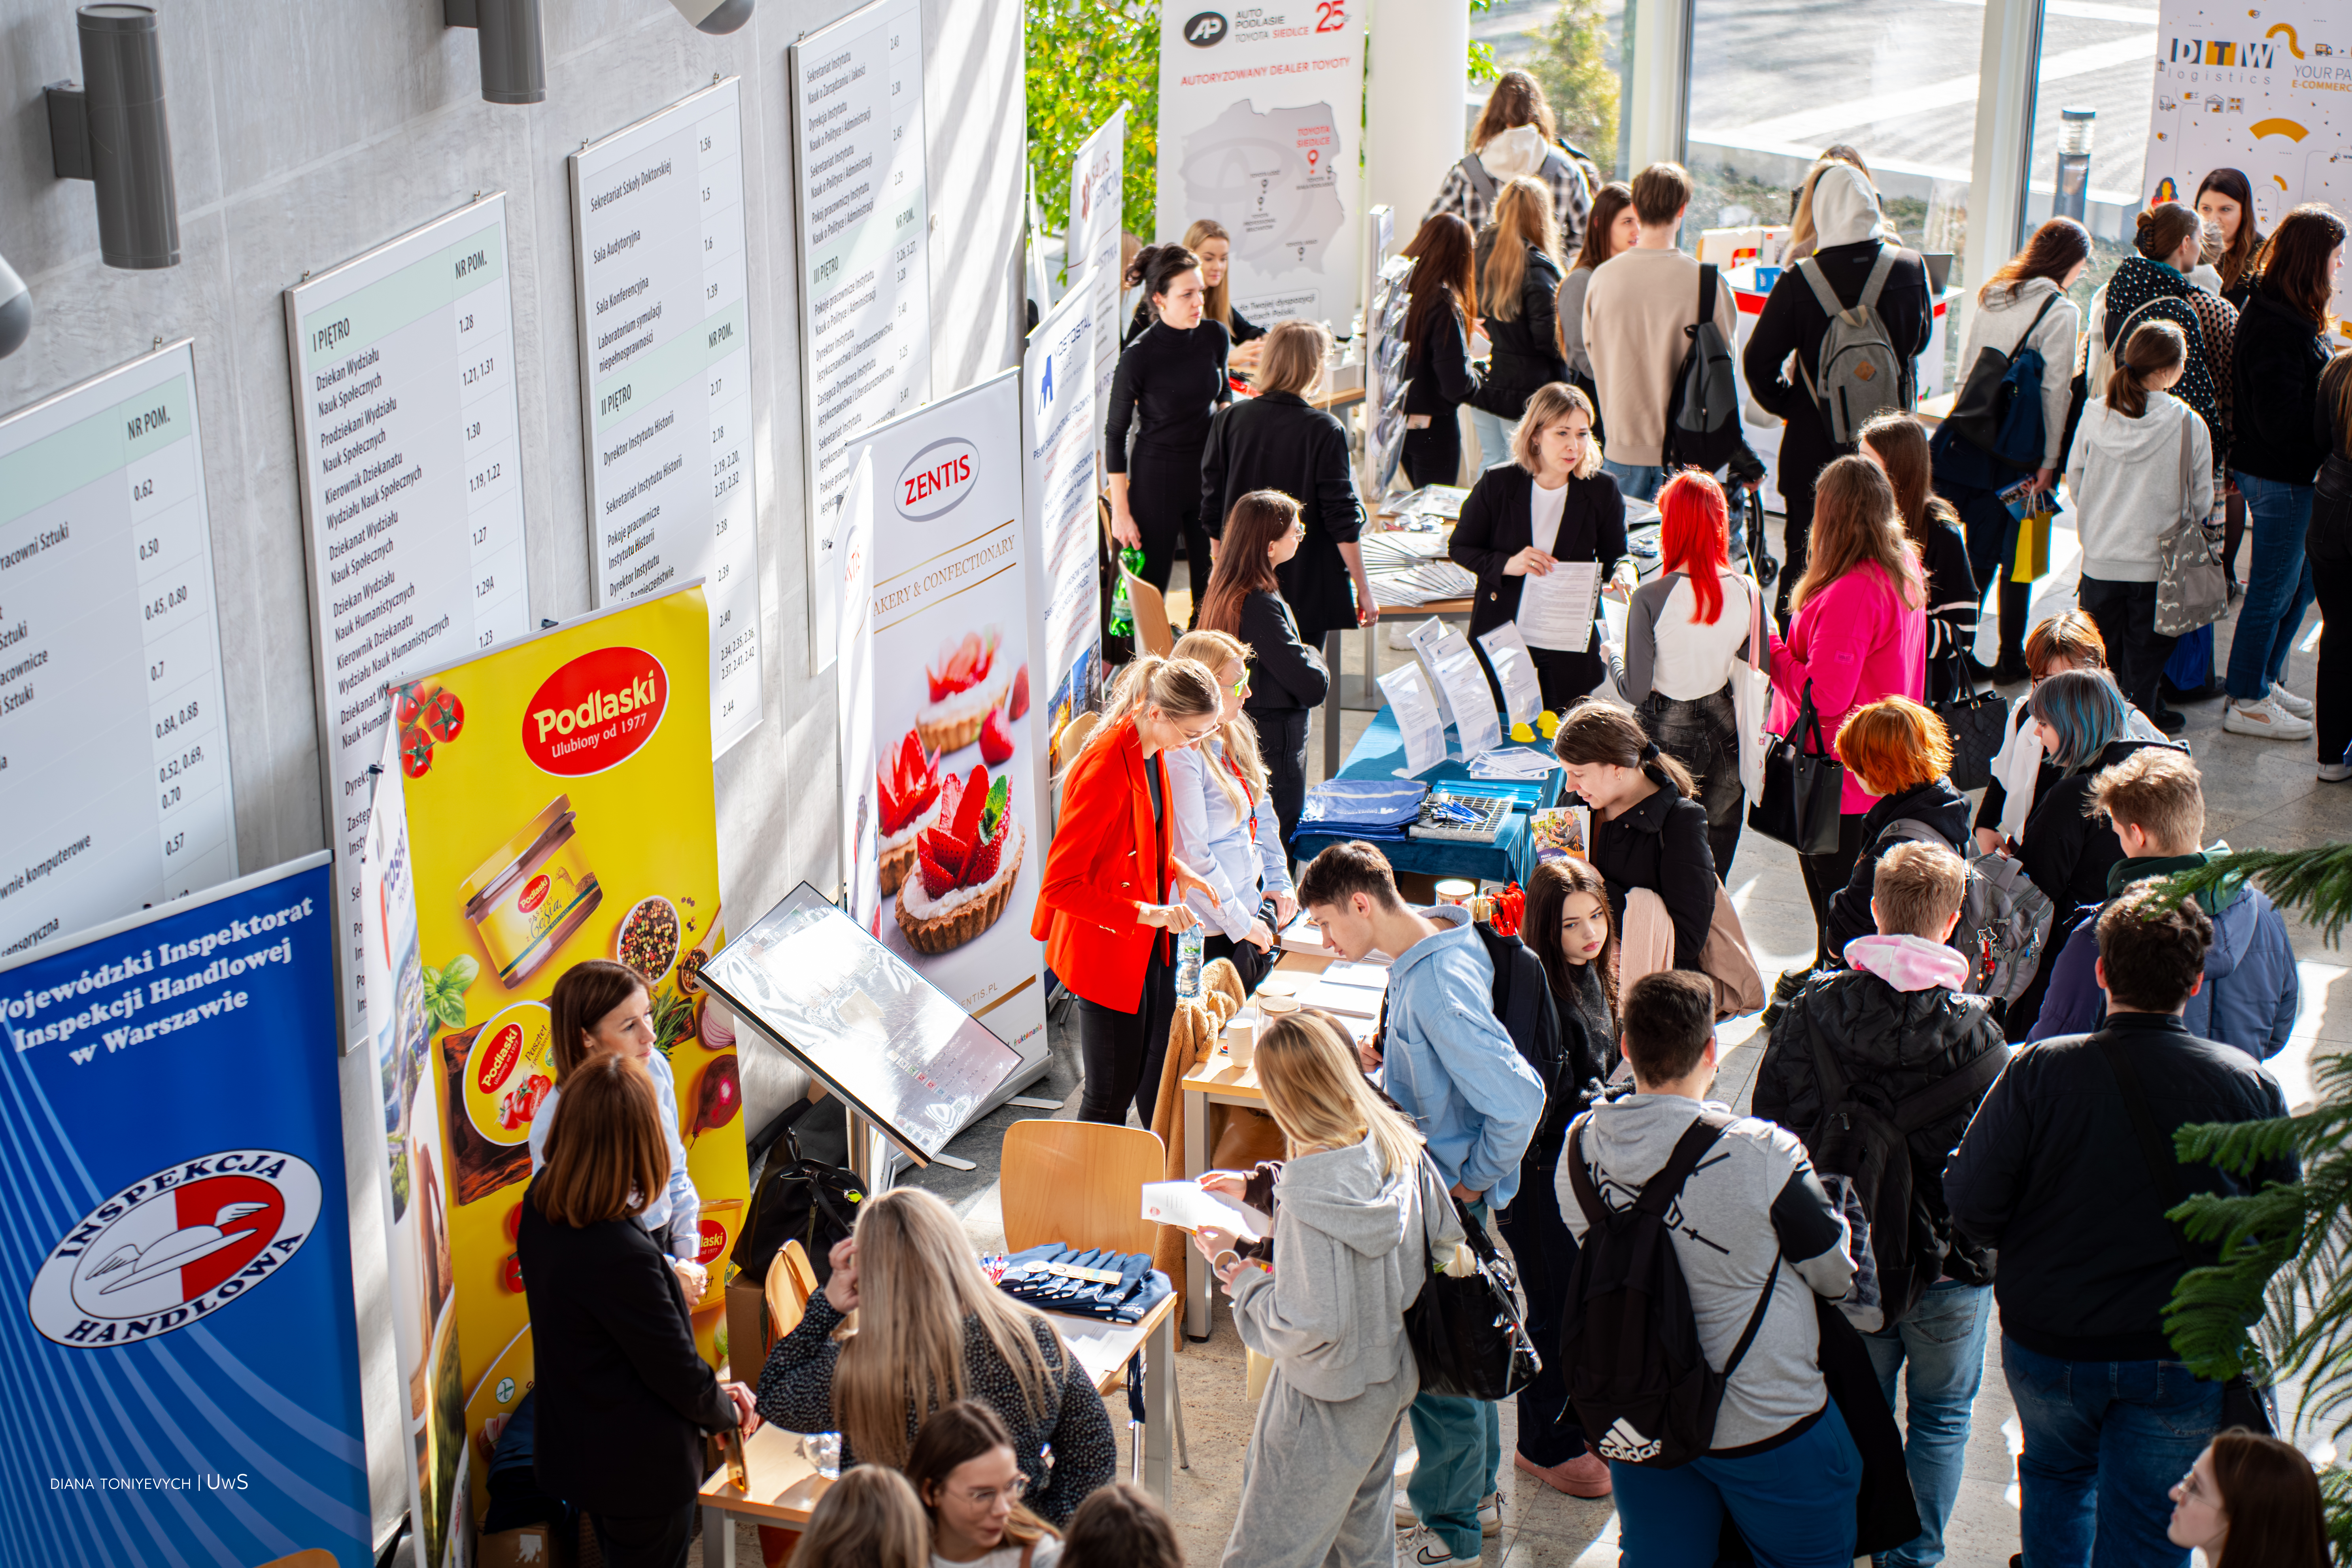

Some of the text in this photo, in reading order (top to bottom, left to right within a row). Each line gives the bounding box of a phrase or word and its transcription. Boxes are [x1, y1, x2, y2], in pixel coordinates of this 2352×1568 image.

[1235, 9, 1263, 20] AUTO
[1235, 15, 1285, 29] PODLASIE
[1315, 0, 1346, 34] 25
[890, 35, 899, 50] 2.43
[1235, 27, 1309, 43] TOYOTA SIEDLCE
[807, 51, 851, 83] Sekretariat Instytutu
[2171, 38, 2274, 69] DTW
[807, 62, 865, 105] Nauk o Zarządzaniu i Jakości
[1180, 57, 1351, 87] AUTORYZOWANY DEALER TOYOTY
[2168, 67, 2271, 85] logistics
[2294, 65, 2332, 79] YOUR
[699, 136, 711, 153] 1.56
[1296, 137, 1331, 148] SIEDLCE
[1297, 126, 1331, 137] TOYOTA
[591, 158, 671, 212] Sekretariat Szkoły Doktorskiej
[702, 187, 710, 202] 1.5
[895, 207, 914, 229] NR POM.
[593, 230, 640, 264] Sala Audytoryjna
[704, 236, 712, 251] 1.6
[455, 249, 487, 279] NR POM.
[820, 255, 839, 280] PIĘTRO
[596, 277, 648, 315] Sala Konferencyjna
[707, 283, 718, 300] 1.39
[313, 317, 349, 352] I PIĘTRO
[459, 314, 474, 333] 1.28
[598, 301, 661, 349] Laboratorium symulacji
[708, 322, 733, 349] NR POM.
[599, 329, 653, 372] niepełnosprawności
[316, 348, 379, 391] Dziekan Wydziału
[463, 357, 493, 386] 1.21, 1.31
[318, 372, 382, 417] Nauk Społecznych
[601, 383, 631, 416] II PIĘTRO
[710, 378, 722, 396] 2.17
[127, 405, 170, 440] NR POM.
[321, 397, 397, 448] Prodziekani Wydziału
[466, 421, 480, 440] 1.30
[712, 425, 724, 443] 2.18
[323, 428, 385, 474] Nauk Społecznych
[603, 410, 674, 467] Dyrektor Instytutu Historii
[134, 479, 153, 501] 0.62
[325, 453, 402, 504] Kierownik Dziekanatu
[905, 454, 970, 506] ZENTIS
[327, 465, 421, 530] Wydziału Nauk Społecznych
[473, 526, 486, 546] 1.27
[716, 518, 727, 536] 2.38
[0, 521, 69, 570] racowni Sztuki
[140, 538, 159, 560] 0.50
[476, 576, 494, 598] 1.29A
[718, 564, 729, 582] 2.39
[873, 535, 1015, 617] AKERY & CONFECTIONARY
[145, 585, 187, 620] 0.45, 0.80
[334, 582, 414, 642] Nauk Humanistycznych
[720, 609, 731, 627] 2.40
[151, 660, 164, 681] 0.7
[156, 701, 198, 739] 0.8A, 0.8B
[533, 669, 656, 743] Podlaski
[723, 699, 734, 715] 2.44
[552, 712, 647, 758] Ulubiony od 1977
[166, 832, 184, 856] 0.57
[520, 877, 548, 909] Podlaski
[158, 896, 314, 967] Inspektorat
[13, 987, 145, 1053] Inspekcji
[149, 936, 293, 1005] Handlowej
[68, 990, 249, 1066] w Warszawie
[525, 1024, 547, 1061] Pasztet
[481, 1028, 518, 1087] Podlaski
[532, 1027, 552, 1066] pomidoram
[55, 1154, 287, 1260] INSPEKCJA
[700, 1232, 723, 1248] laski
[64, 1233, 304, 1344] HANDLOWA
[1598, 1438, 1662, 1462] adidas
